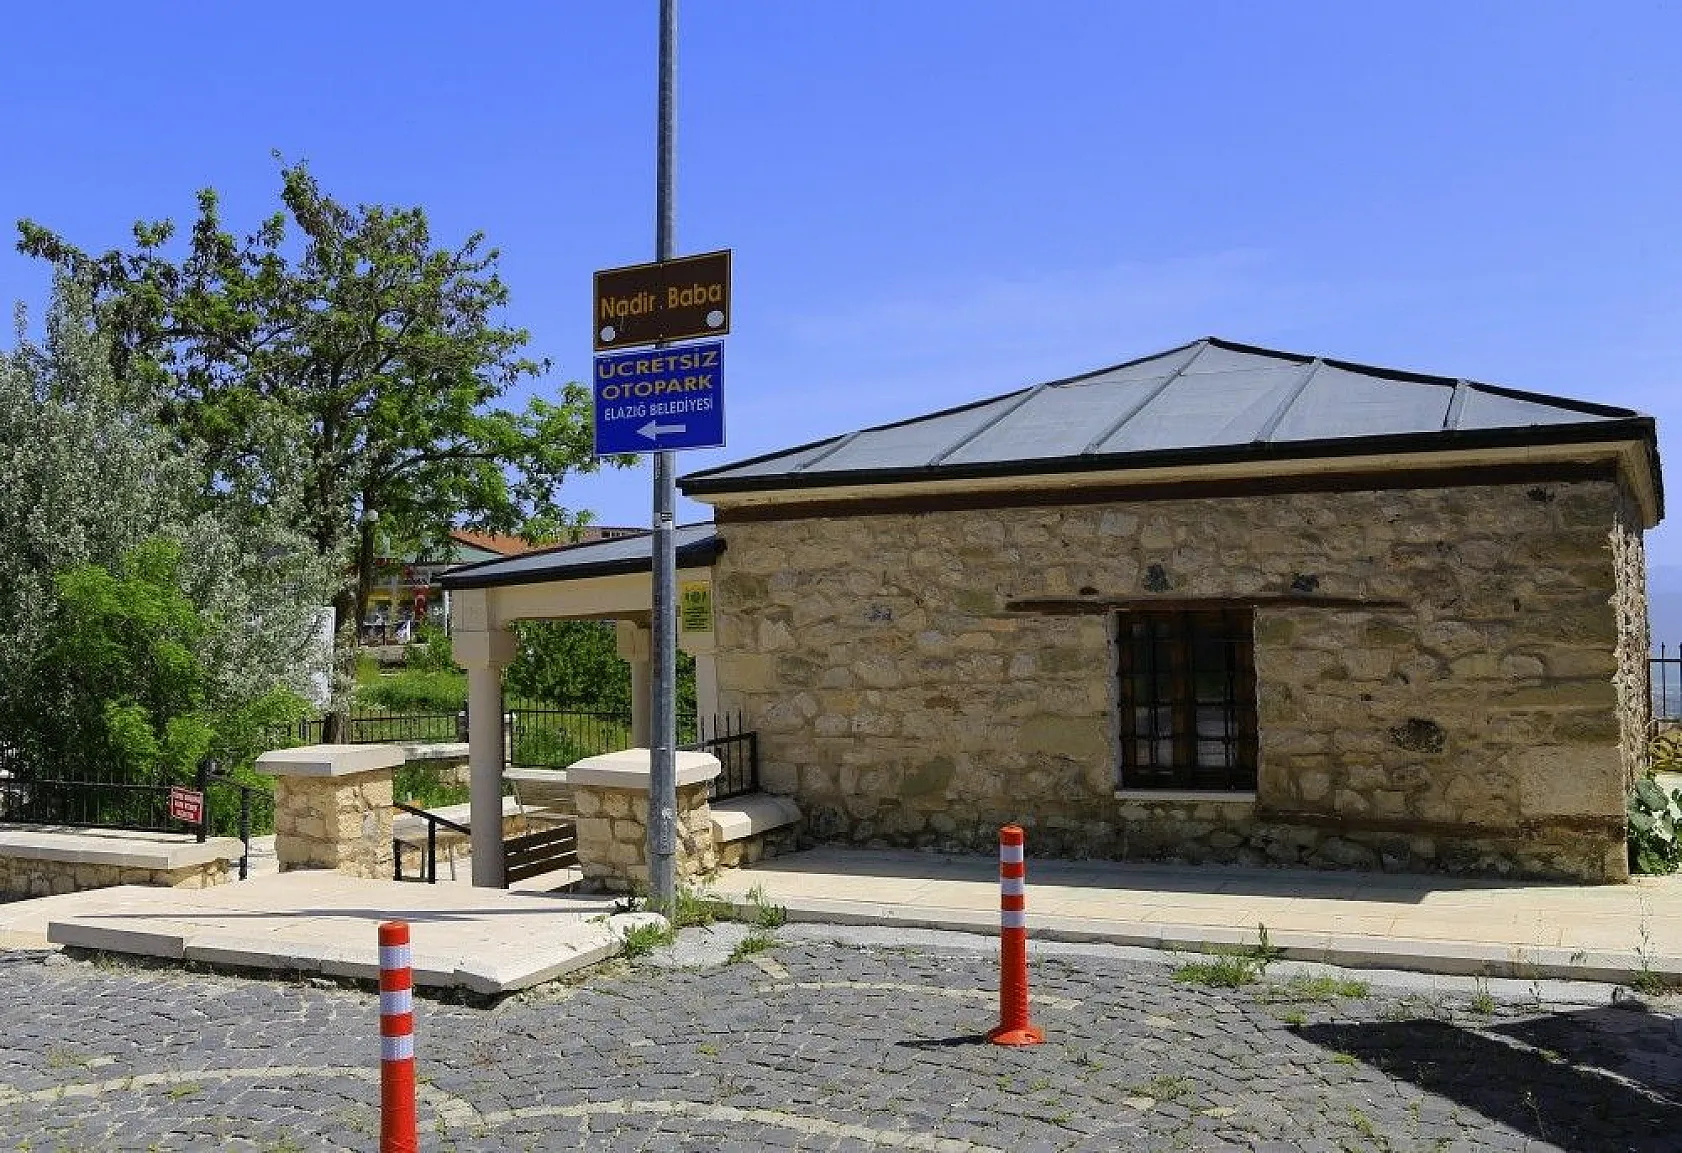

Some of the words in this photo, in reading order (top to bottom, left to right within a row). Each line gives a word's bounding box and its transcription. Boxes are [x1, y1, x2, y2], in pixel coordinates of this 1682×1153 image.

[601, 291, 656, 319] Nadir
[668, 283, 722, 309] Baba
[600, 348, 719, 378] ÜCRETSİZ
[602, 375, 713, 399] OTOPARK
